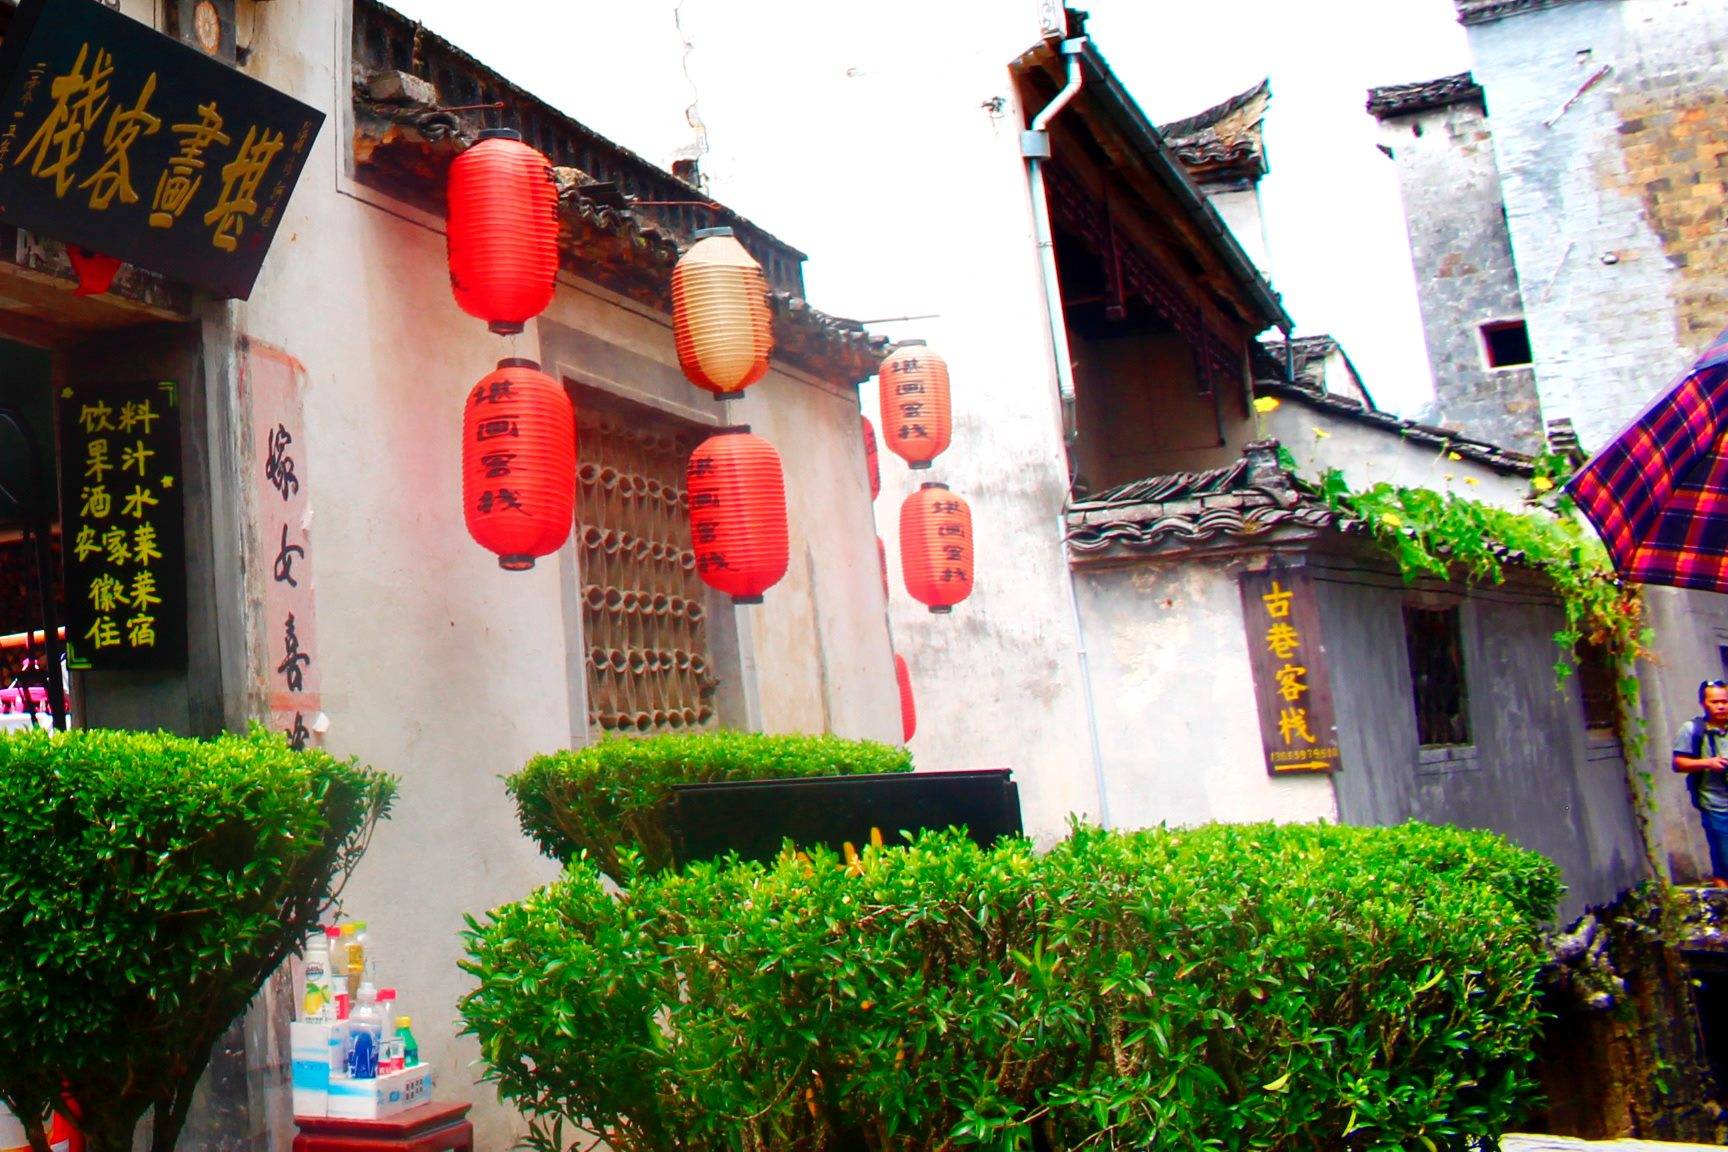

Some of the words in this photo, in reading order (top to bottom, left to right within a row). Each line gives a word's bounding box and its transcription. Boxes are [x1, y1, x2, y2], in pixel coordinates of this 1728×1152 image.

[79, 399, 160, 434] 饮料
[83, 440, 155, 482] 果汁
[80, 485, 159, 518] 酒水
[74, 521, 163, 566] 农家菜
[88, 569, 162, 611] 徽菜
[84, 612, 155, 649] 住宿
[1262, 581, 1317, 744] 古巷客栈
